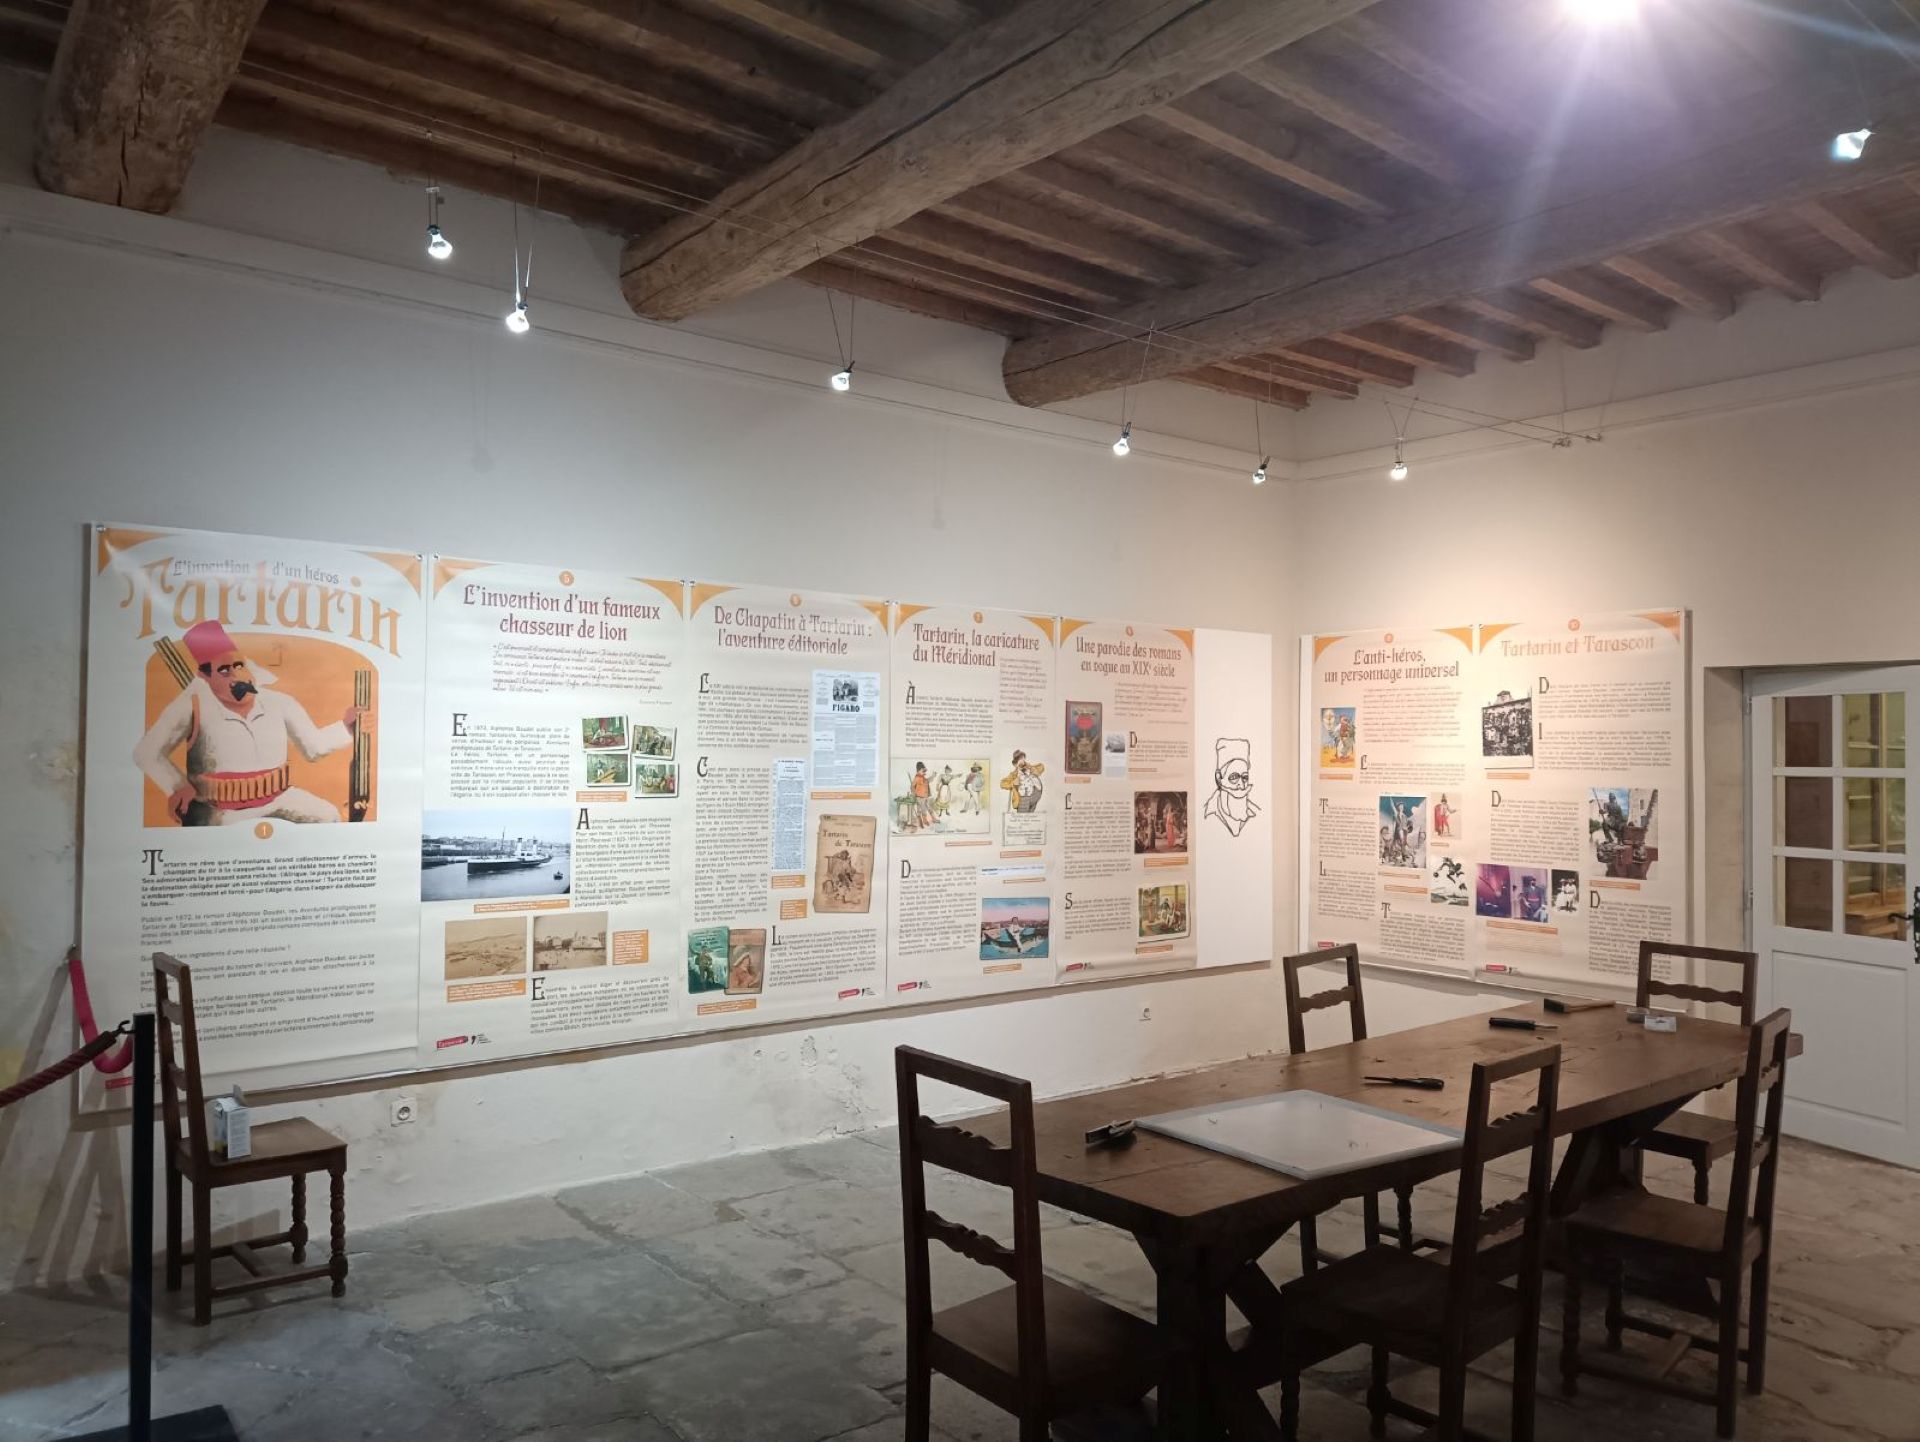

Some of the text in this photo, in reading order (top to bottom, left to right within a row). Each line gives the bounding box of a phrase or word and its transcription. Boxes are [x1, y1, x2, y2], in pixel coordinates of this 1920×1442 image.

[272, 561, 302, 578] d'un
[305, 564, 340, 585] héros
[119, 556, 401, 658] Tartarin
[463, 584, 661, 620] L'invention d'un fameux
[500, 613, 628, 641] chasseur de lion
[714, 606, 732, 625] De
[736, 607, 796, 633] Chapatin
[799, 614, 806, 632] à
[809, 614, 865, 636] Tartarin
[718, 628, 848, 655] l'aventure éditoriale
[913, 623, 1040, 651] Tartarin, la caricature
[1076, 636, 1182, 660] Une parodie des romans
[1501, 635, 1655, 657] Tartarin et Tarascon
[912, 644, 996, 667] du Méridional
[1353, 648, 1427, 666] L'anti-héros,
[1080, 660, 1092, 671] en
[1120, 664, 1131, 674] au
[1153, 663, 1175, 677] siècle
[1324, 661, 1460, 686] un personnage universel
[832, 703, 860, 713] FIGARO
